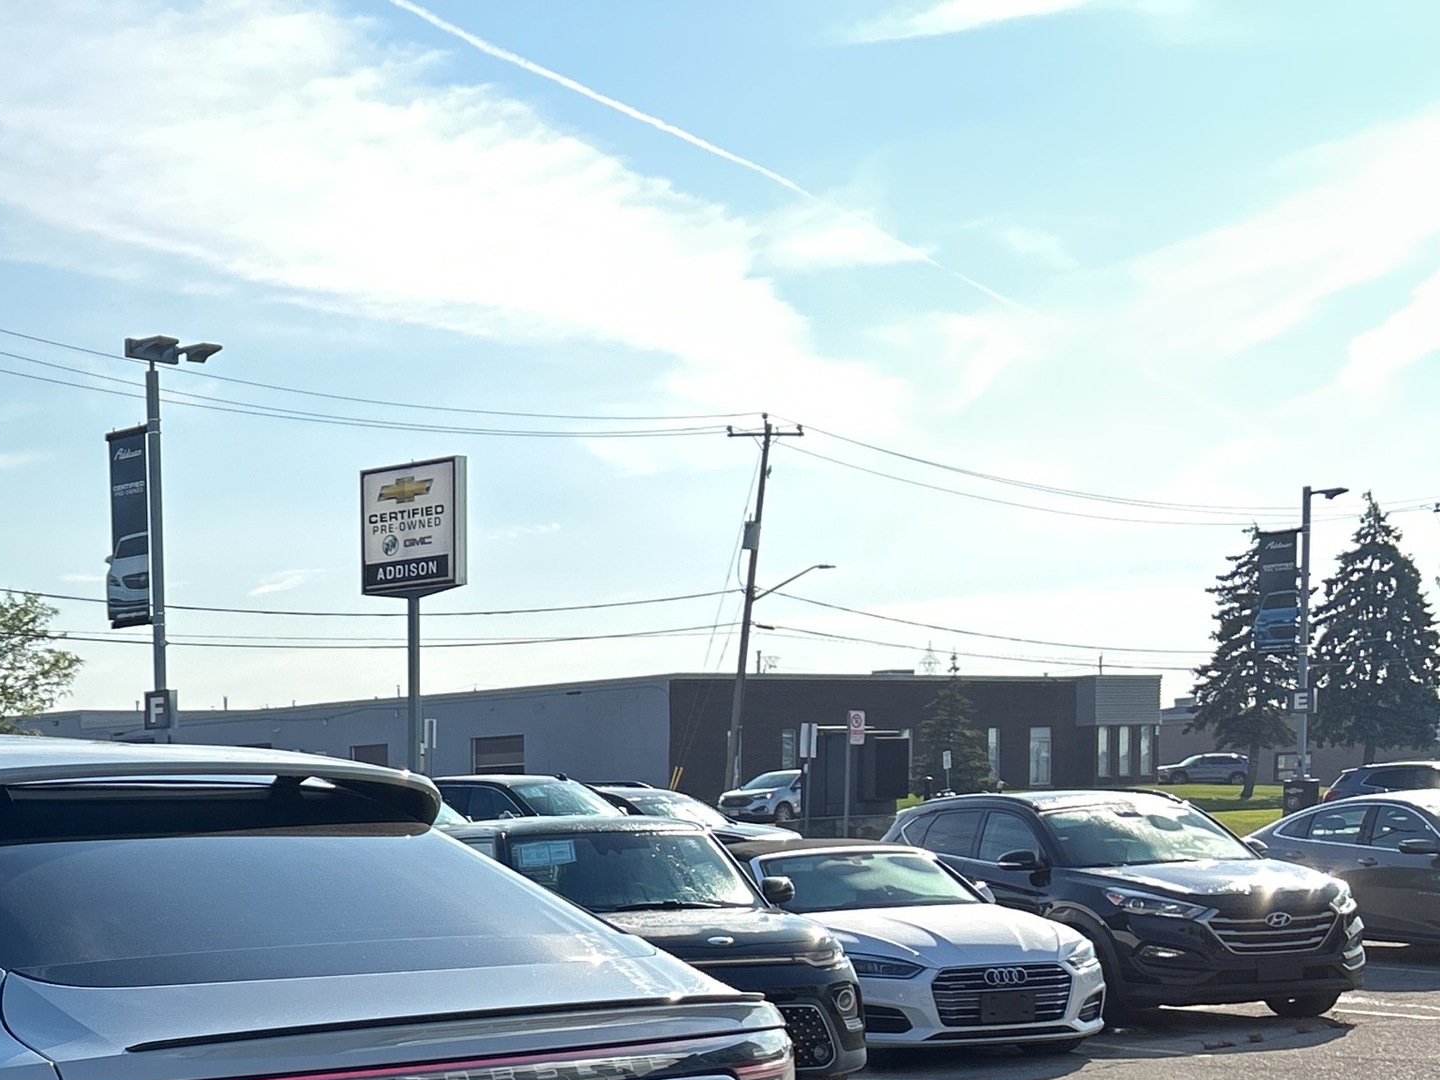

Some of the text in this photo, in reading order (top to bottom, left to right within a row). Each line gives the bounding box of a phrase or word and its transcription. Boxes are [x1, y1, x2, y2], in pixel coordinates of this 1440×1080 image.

[368, 504, 445, 525] CERTIFIED
[372, 516, 442, 535] PRE-OWNED
[403, 535, 433, 548] GMC
[376, 560, 437, 581] ADDISON
[150, 696, 165, 723] F
[1293, 692, 1309, 710] E
